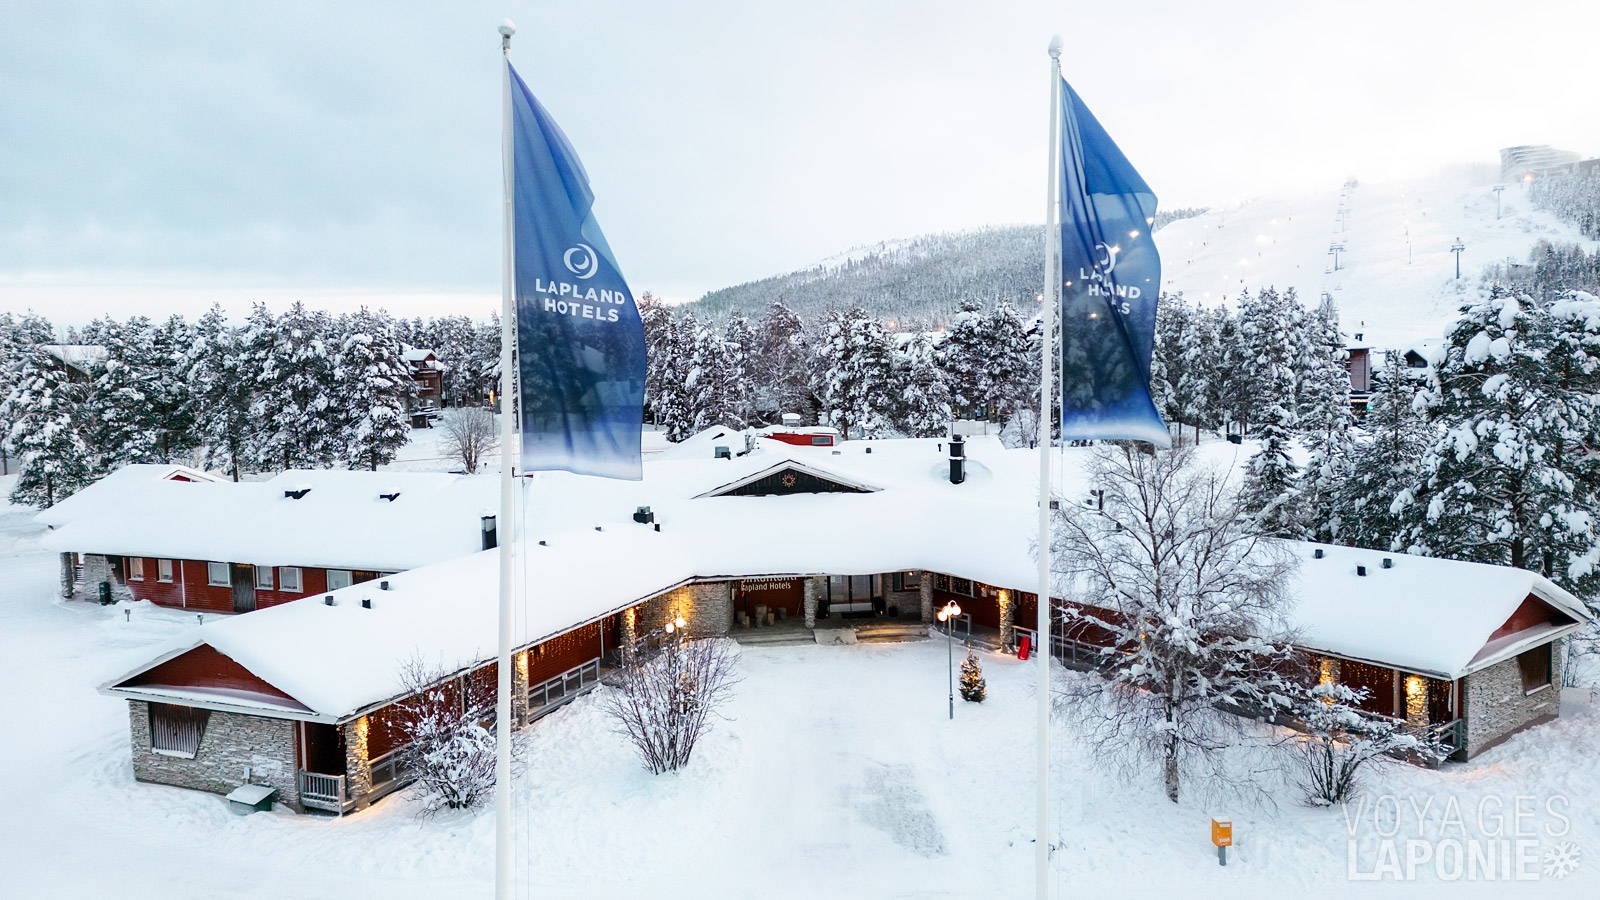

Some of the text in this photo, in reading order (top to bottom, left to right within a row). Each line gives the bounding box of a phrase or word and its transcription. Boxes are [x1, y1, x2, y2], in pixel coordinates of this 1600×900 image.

[535, 278, 625, 305] LAPLAND
[544, 298, 619, 323] HOTELS
[741, 582, 791, 592] Lapland Hotels
